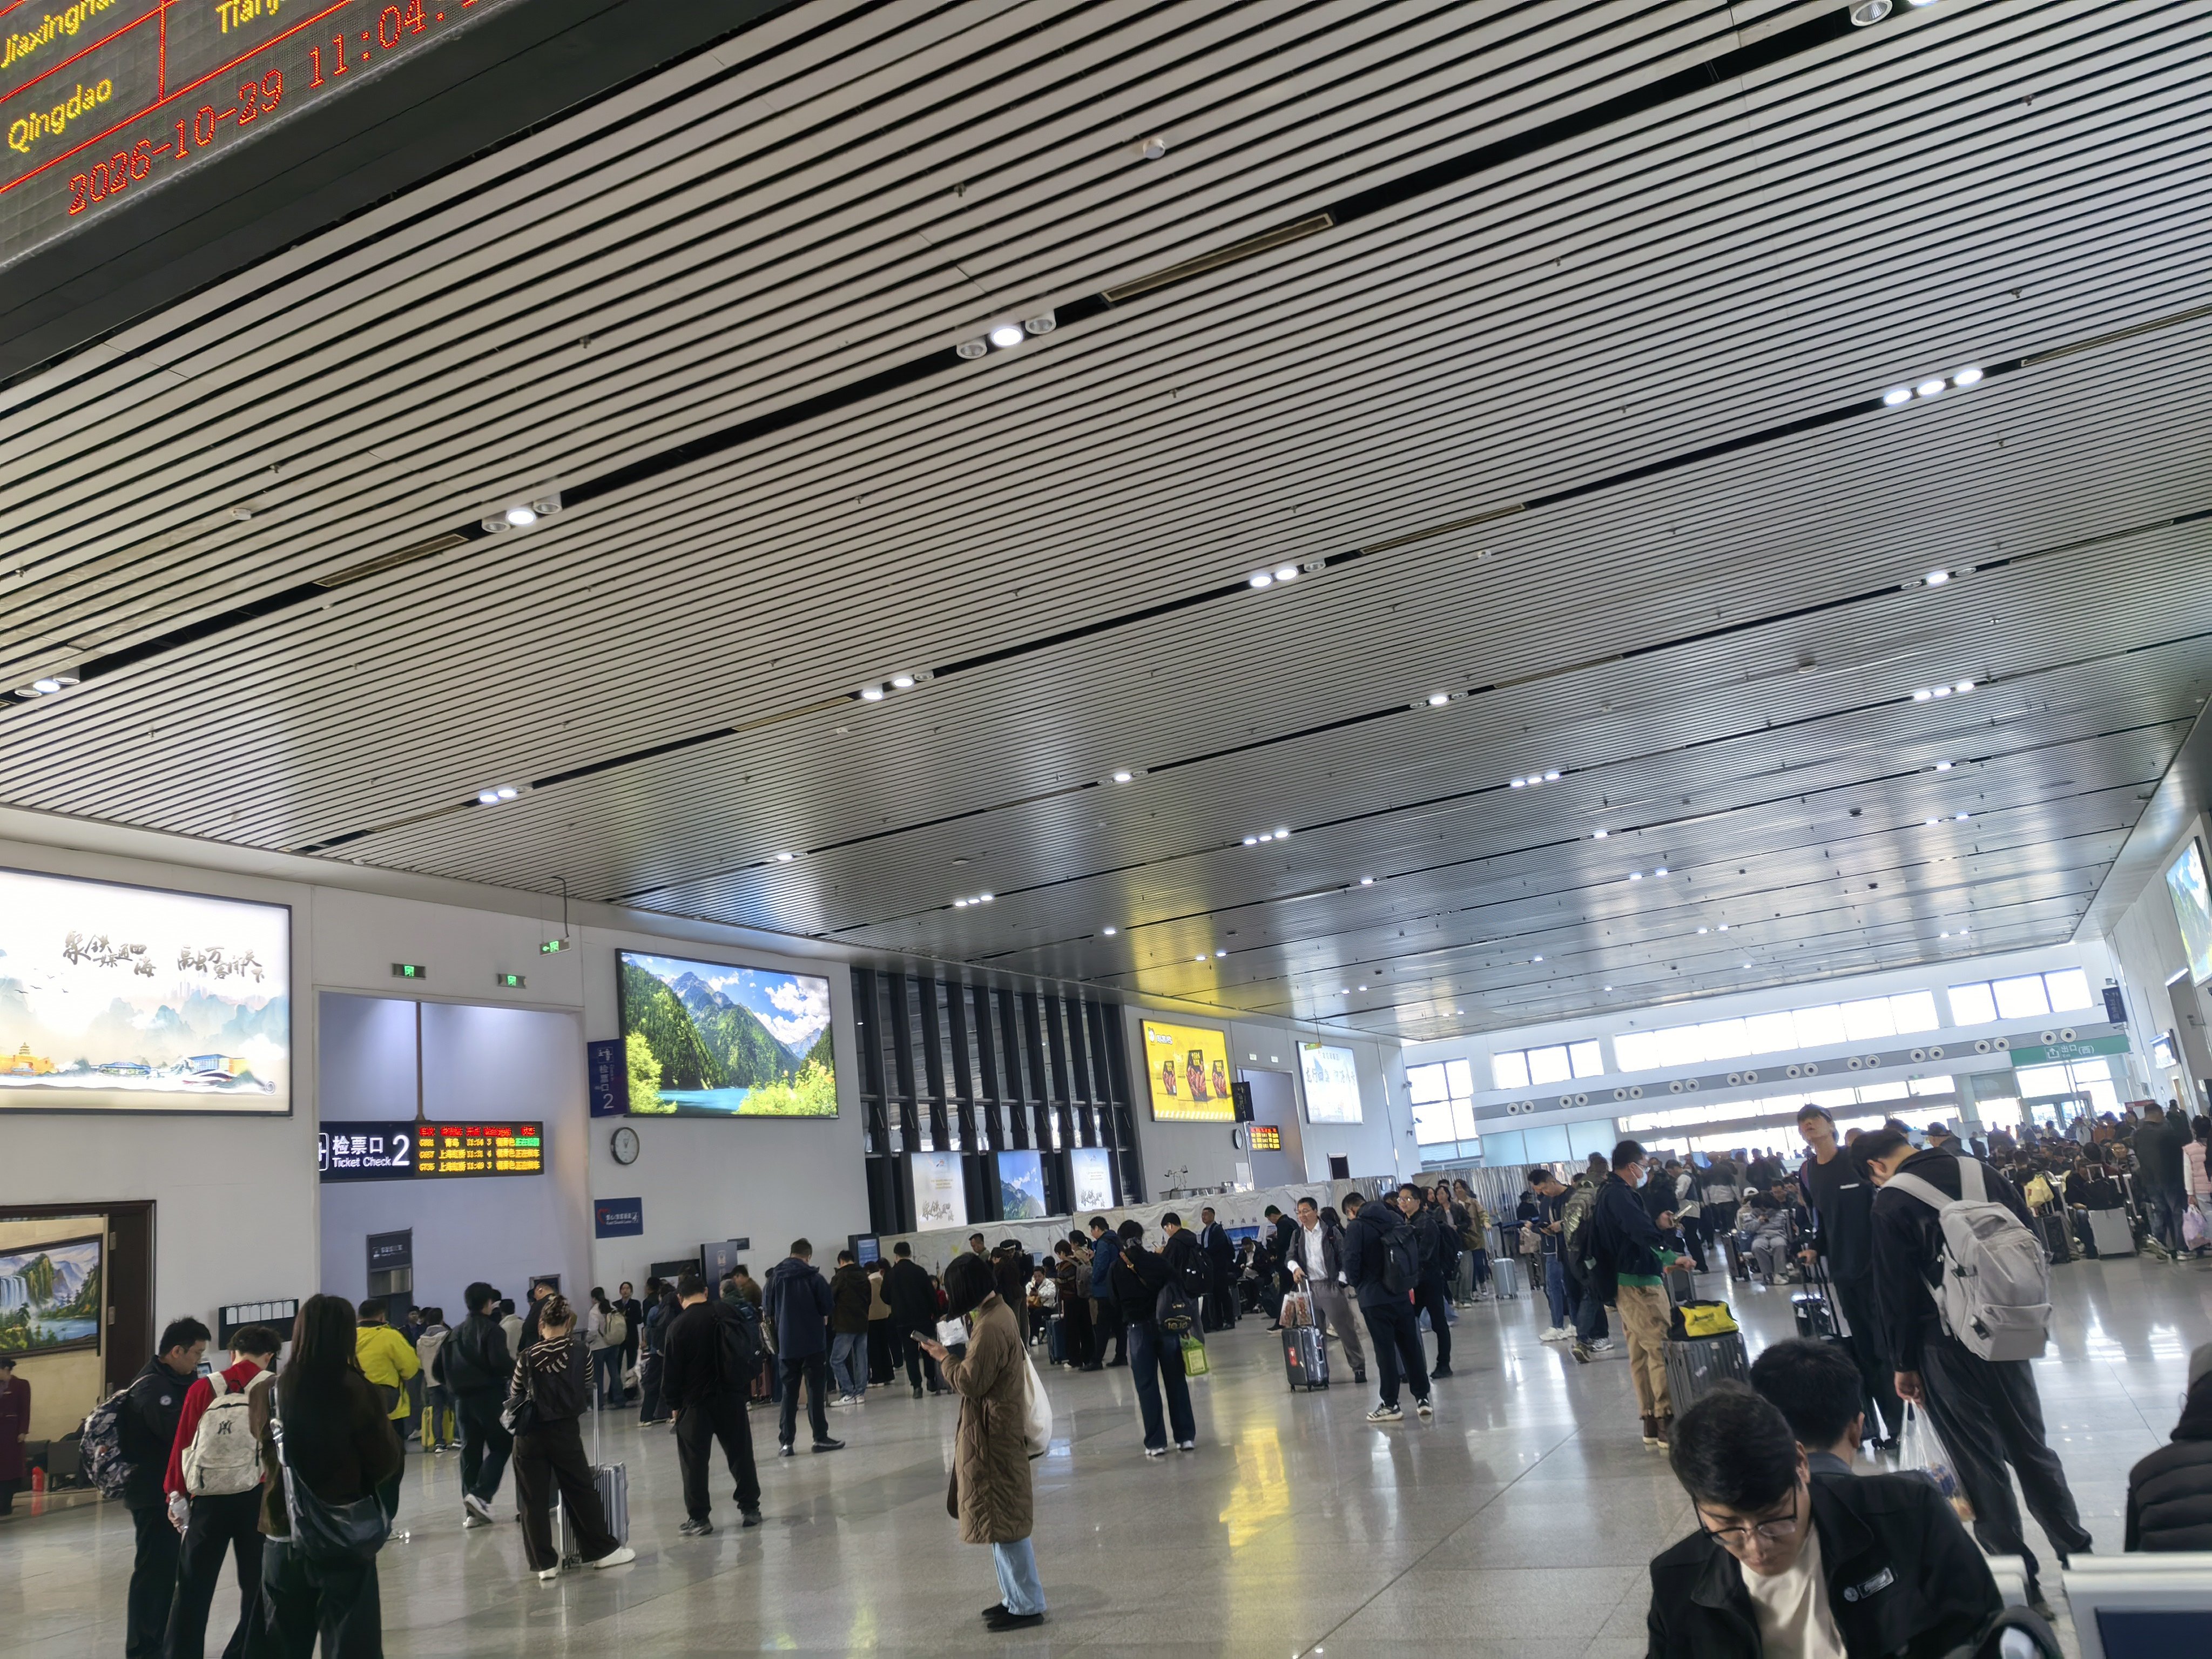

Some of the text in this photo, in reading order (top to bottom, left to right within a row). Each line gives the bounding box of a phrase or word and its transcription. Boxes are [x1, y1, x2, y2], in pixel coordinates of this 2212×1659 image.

[8, 79, 112, 153] Qingdao
[69, 68, 283, 215] 2026-10-29
[603, 1093, 614, 1109] 2
[332, 1135, 410, 1166] 检票口 2
[332, 1156, 392, 1168] Ticket Check
